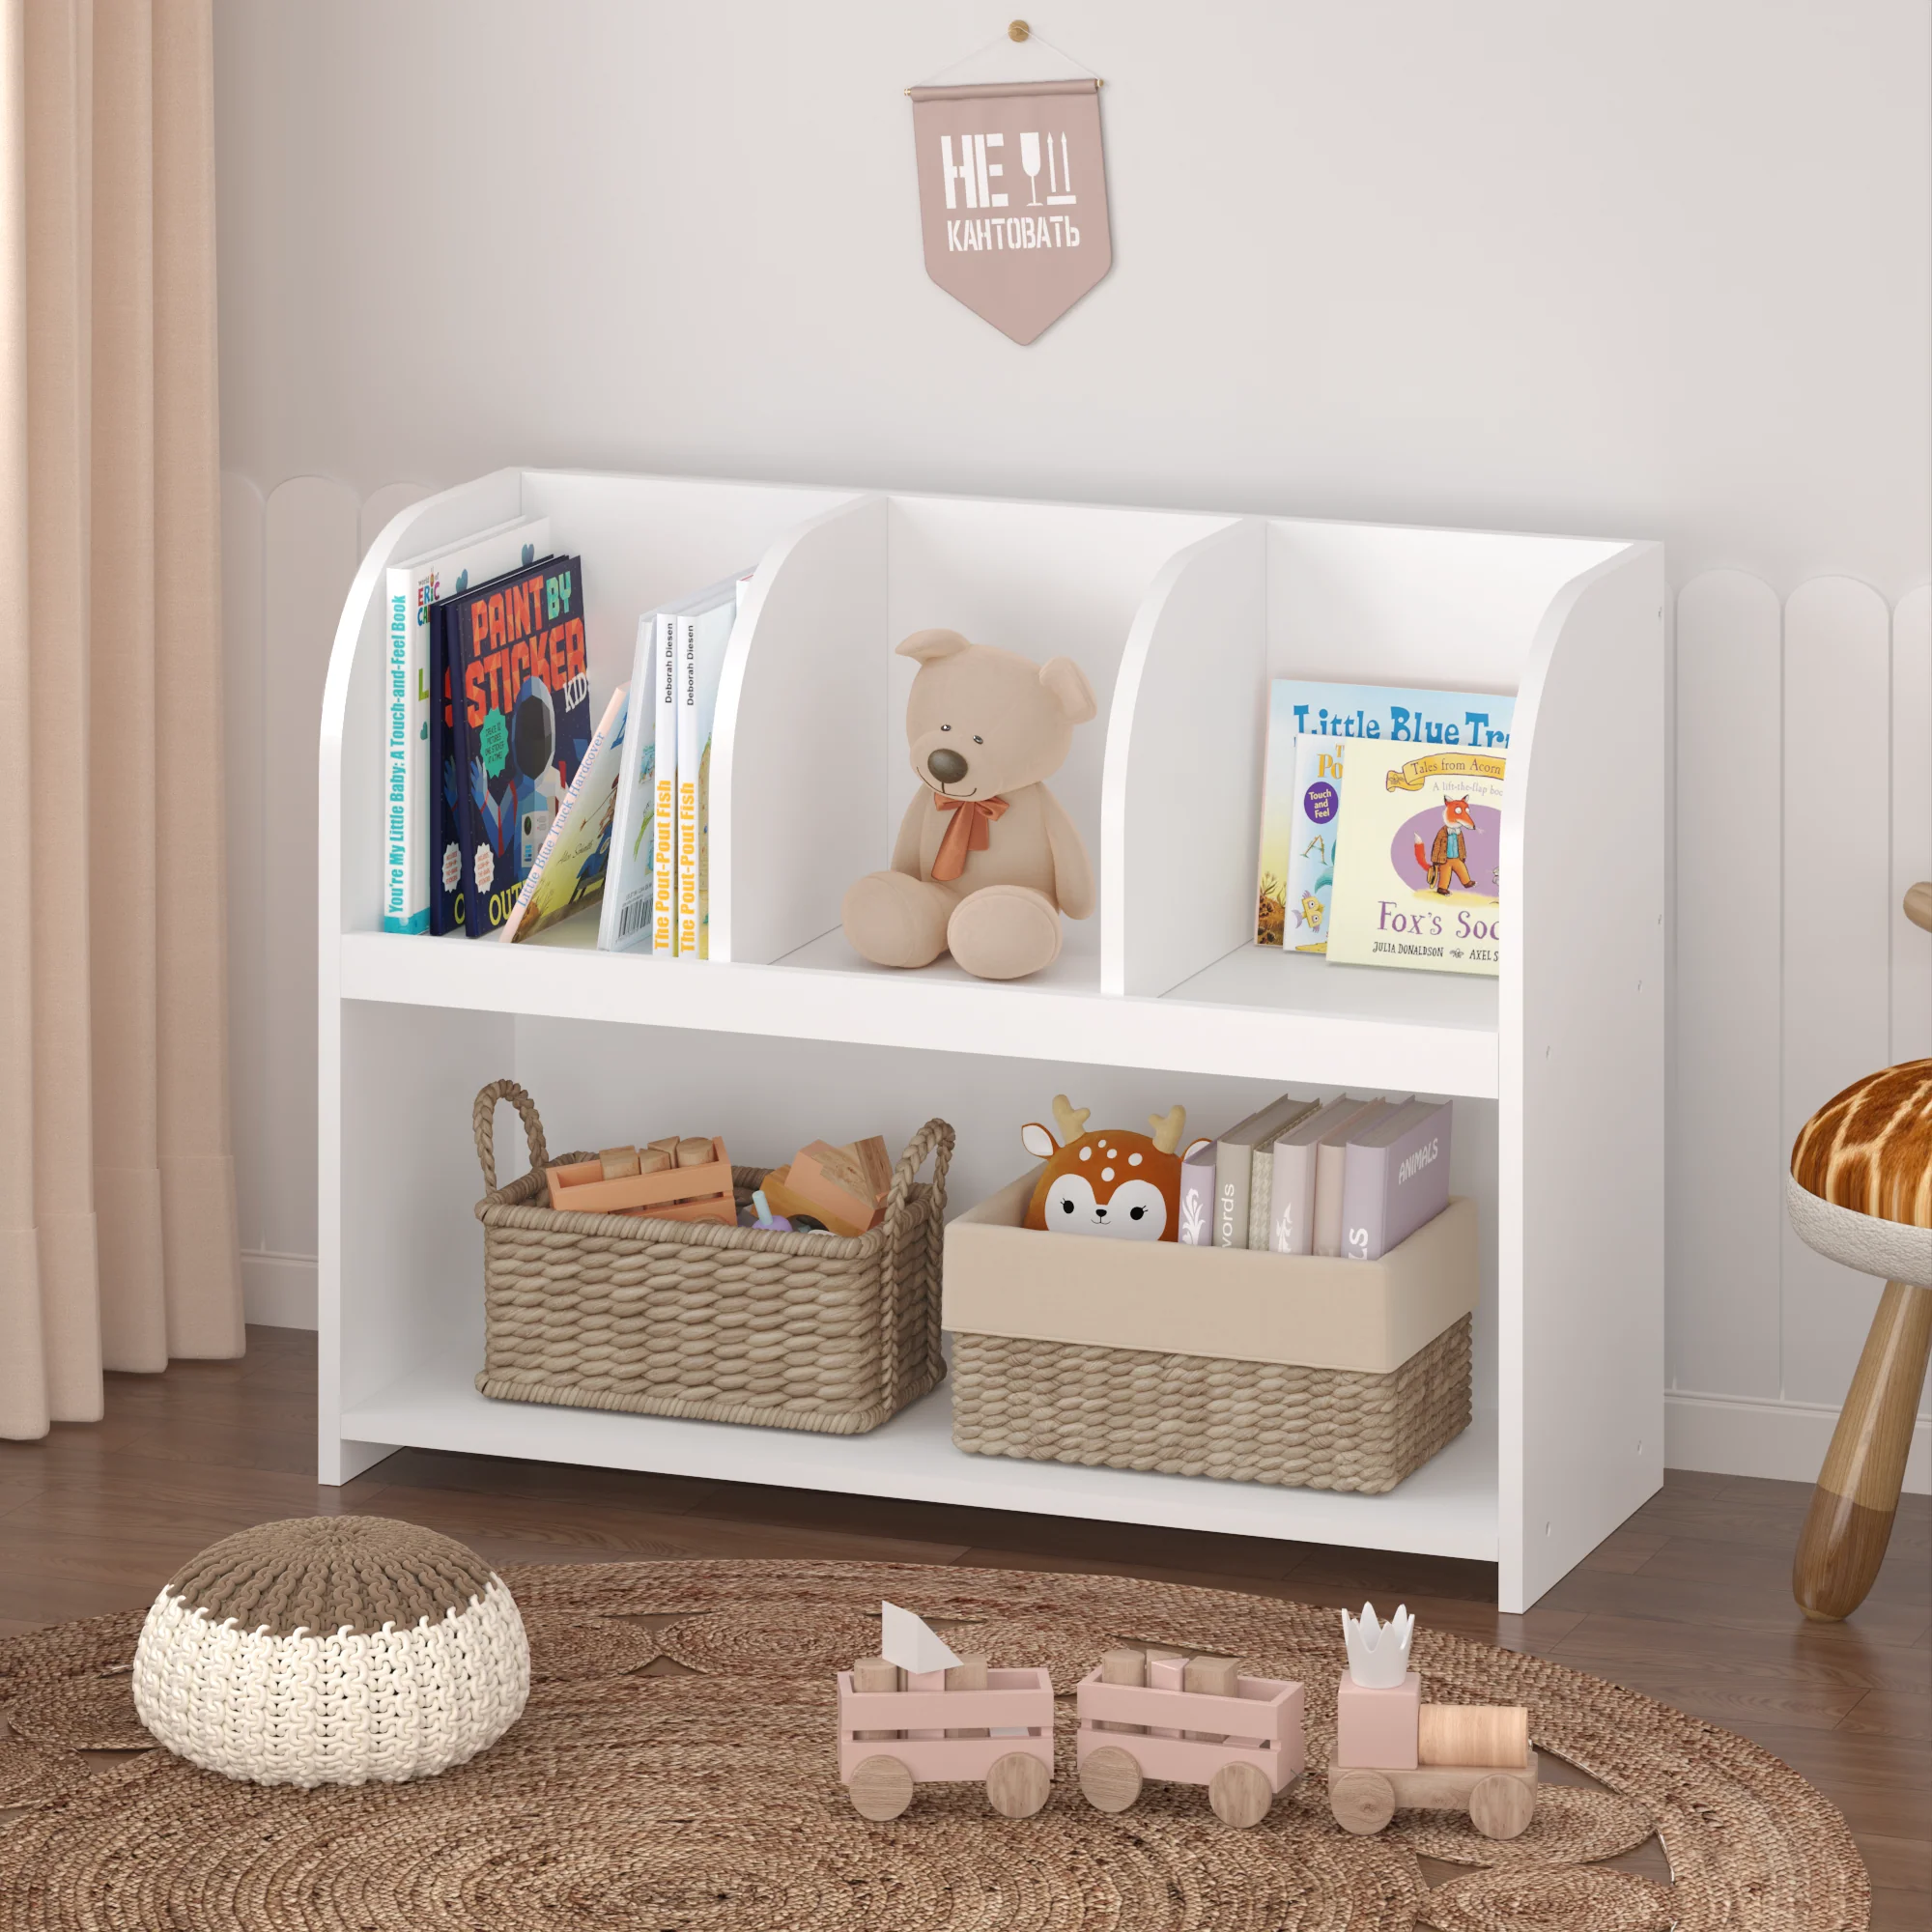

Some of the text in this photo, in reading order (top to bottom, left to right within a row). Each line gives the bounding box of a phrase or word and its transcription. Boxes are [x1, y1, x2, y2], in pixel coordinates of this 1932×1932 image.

[941, 133, 1009, 209] НЕ
[947, 215, 1080, 251] КАНТОВАТЬ
[471, 571, 572, 657] PAINT BY
[466, 617, 587, 728] STICKER
[563, 668, 591, 713] KID
[1293, 704, 1380, 739] Little
[1390, 706, 1460, 746] Blue
[388, 595, 406, 913] You're My Little Baby: A Touch-and-Feel Book
[1410, 759, 1501, 775] Tales from Acorn
[1308, 789, 1332, 801] Touch
[1314, 800, 1329, 810] and
[1442, 781, 1488, 796] lift-the-flap
[517, 732, 605, 908] Little Blue Truck Hardcover
[1315, 808, 1330, 819] Feel
[654, 780, 671, 950] The Pout-Pout Fish
[680, 781, 696, 952] The Pout-Pout Fish
[489, 880, 526, 925] OUT
[1378, 900, 1442, 935] Fox's
[1373, 942, 1396, 953] JULIA
[1398, 944, 1444, 957] DONALDSON
[1469, 950, 1492, 961] AXEL
[1398, 1137, 1438, 1186] ANIMALS
